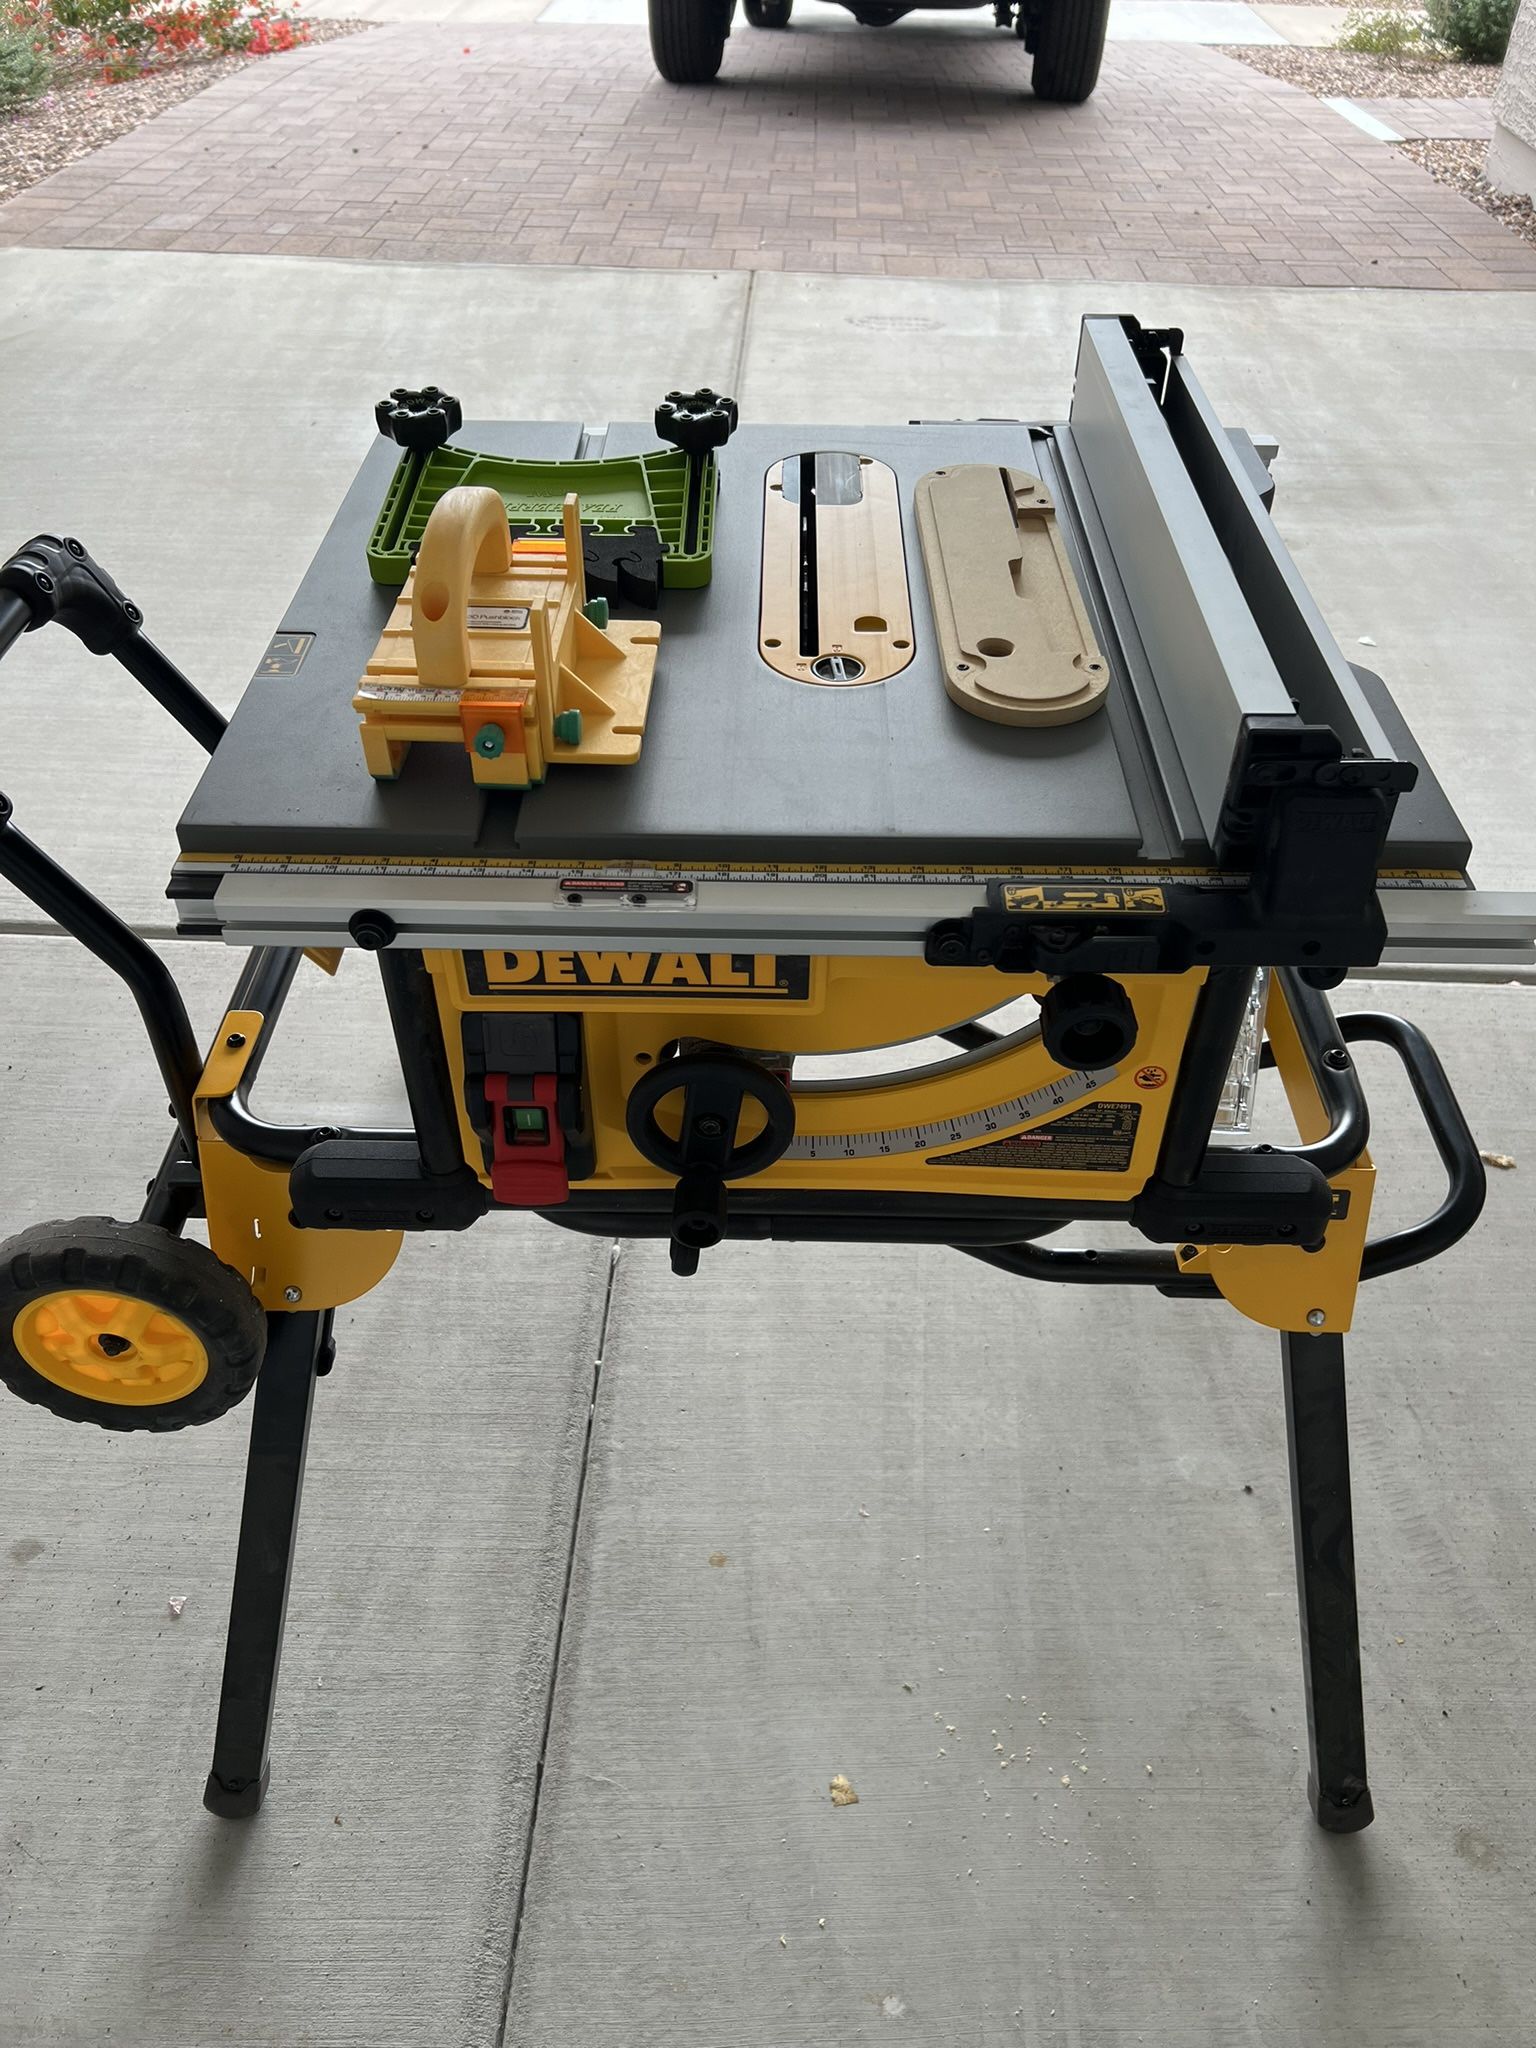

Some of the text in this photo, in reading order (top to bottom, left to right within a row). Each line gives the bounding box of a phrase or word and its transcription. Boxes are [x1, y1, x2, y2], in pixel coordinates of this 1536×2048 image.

[479, 613, 521, 621] Pushblock
[1097, 1102, 1132, 1110] DWE7491
[810, 1150, 816, 1158] 5
[879, 1145, 890, 1153] 15
[914, 1140, 926, 1148] 20
[950, 1132, 962, 1141] 25
[985, 1122, 997, 1131] 30
[1018, 1110, 1031, 1120] 35
[1052, 1096, 1064, 1105] 40
[1085, 1080, 1097, 1090] 45
